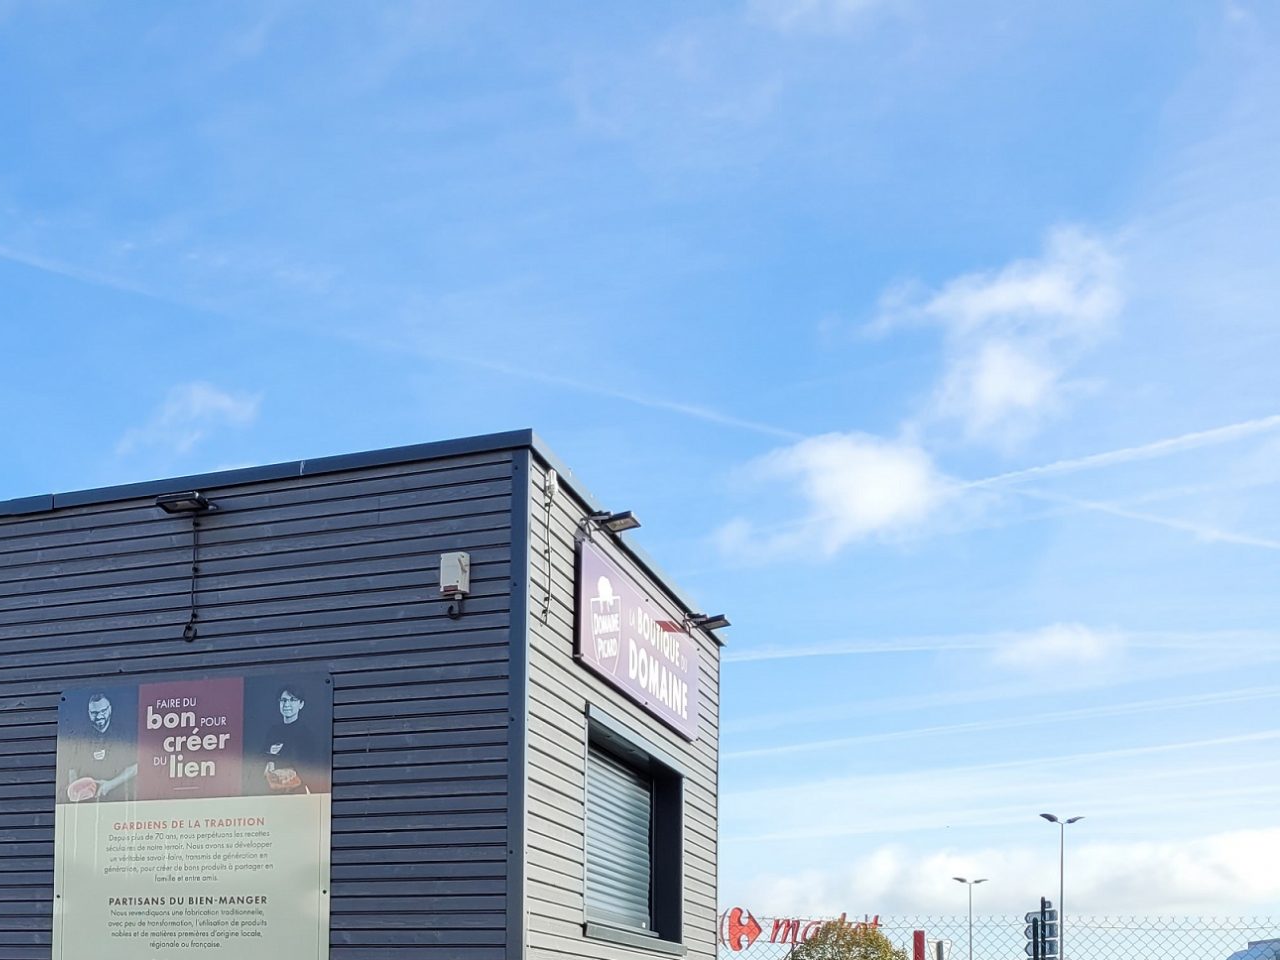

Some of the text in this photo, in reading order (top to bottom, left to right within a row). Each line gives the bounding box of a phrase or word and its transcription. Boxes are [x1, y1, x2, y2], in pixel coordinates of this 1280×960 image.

[594, 612, 619, 635] DOMAINE
[629, 607, 636, 627] LA
[638, 607, 680, 665] BOUTIQUE
[598, 637, 617, 659] PICARD
[628, 638, 688, 720] DOMAINE
[156, 698, 197, 708] FAIRE DU
[147, 706, 226, 730] bon POUR
[163, 727, 230, 752] créer
[154, 755, 215, 778] DU lien
[113, 818, 265, 831] GARDIENS DE LA TRADITION
[131, 833, 144, 842] plus
[197, 831, 233, 841] perpétuons
[186, 842, 203, 850] Nous
[234, 841, 272, 850] développer
[223, 852, 258, 862] génération
[174, 864, 182, 872] de
[201, 863, 227, 873] produits
[235, 863, 263, 872] partager
[109, 896, 267, 906] PARTISANS DU BIEN-MANGER
[147, 920, 194, 928] transformation,
[241, 920, 267, 928] produits
[111, 930, 132, 938] nobles
[141, 930, 149, 938] de
[150, 930, 176, 938] matières
[210, 930, 239, 939] d'origine
[191, 941, 222, 949] française.
